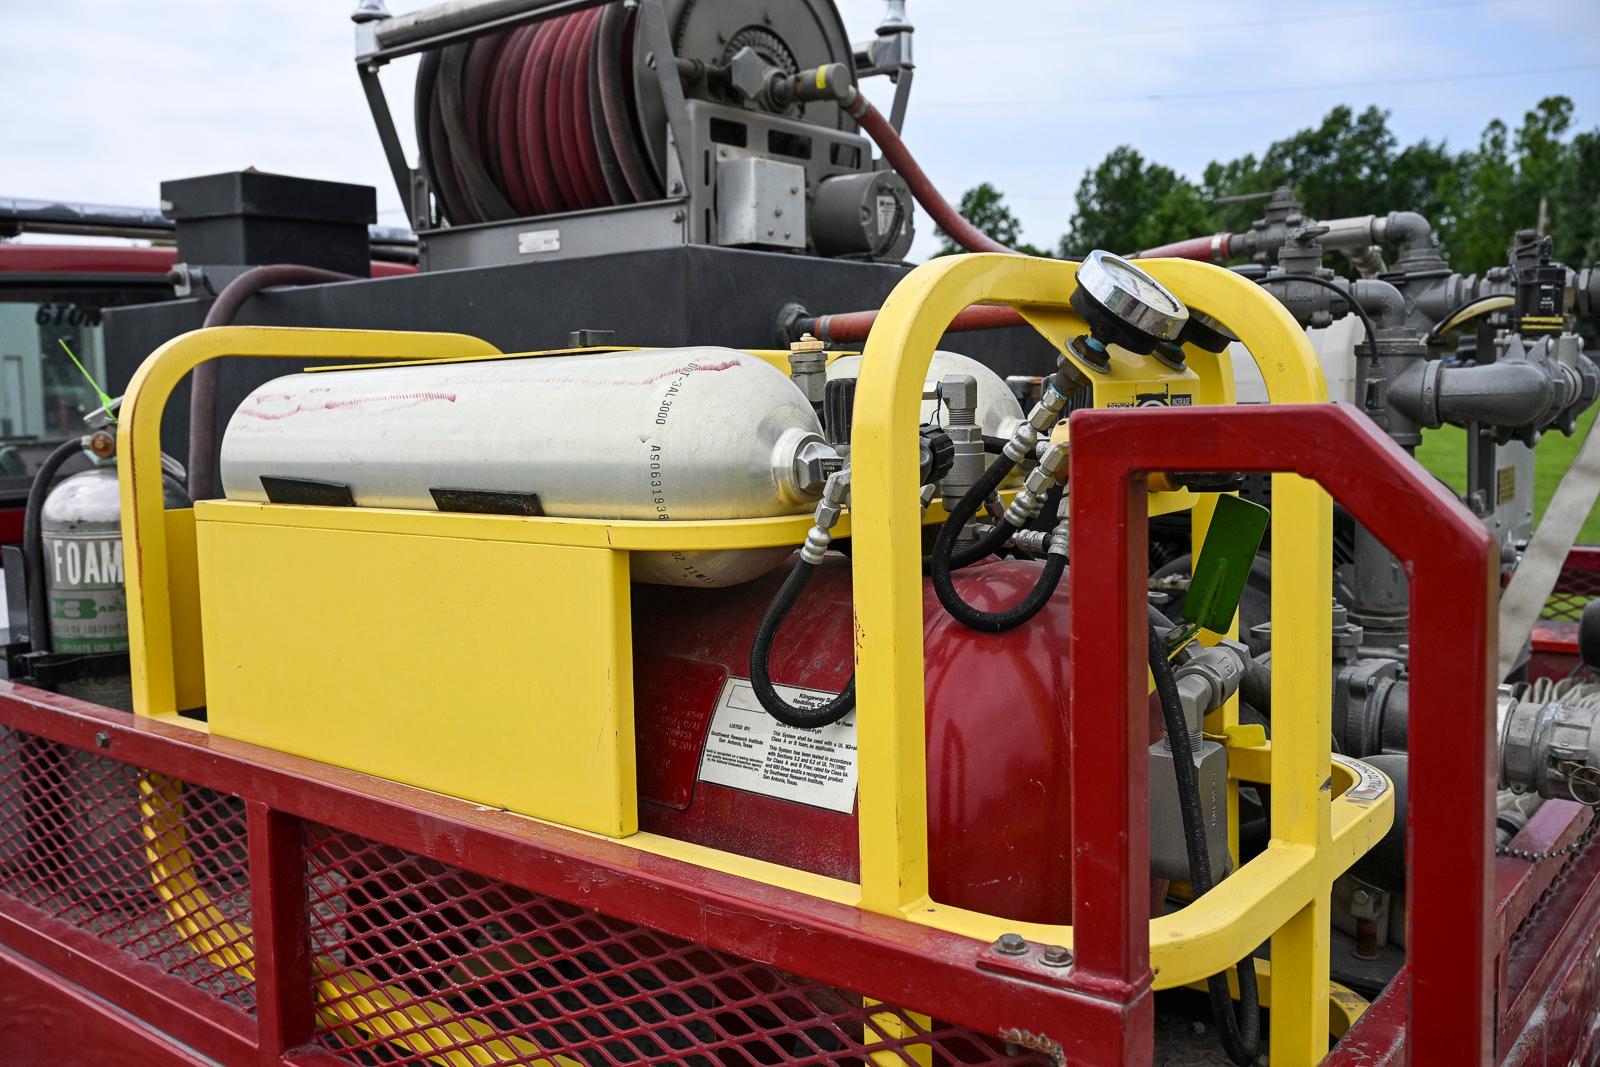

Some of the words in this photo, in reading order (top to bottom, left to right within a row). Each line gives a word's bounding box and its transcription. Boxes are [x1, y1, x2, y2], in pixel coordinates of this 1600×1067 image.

[650, 445, 669, 520] AS0631938
[53, 540, 124, 585] FOAM
[799, 693, 825, 702] Kingsway
[793, 698, 815, 707] Redding,
[830, 757, 851, 765] accordance
[790, 773, 807, 782] Research
[806, 772, 827, 780] recognized
